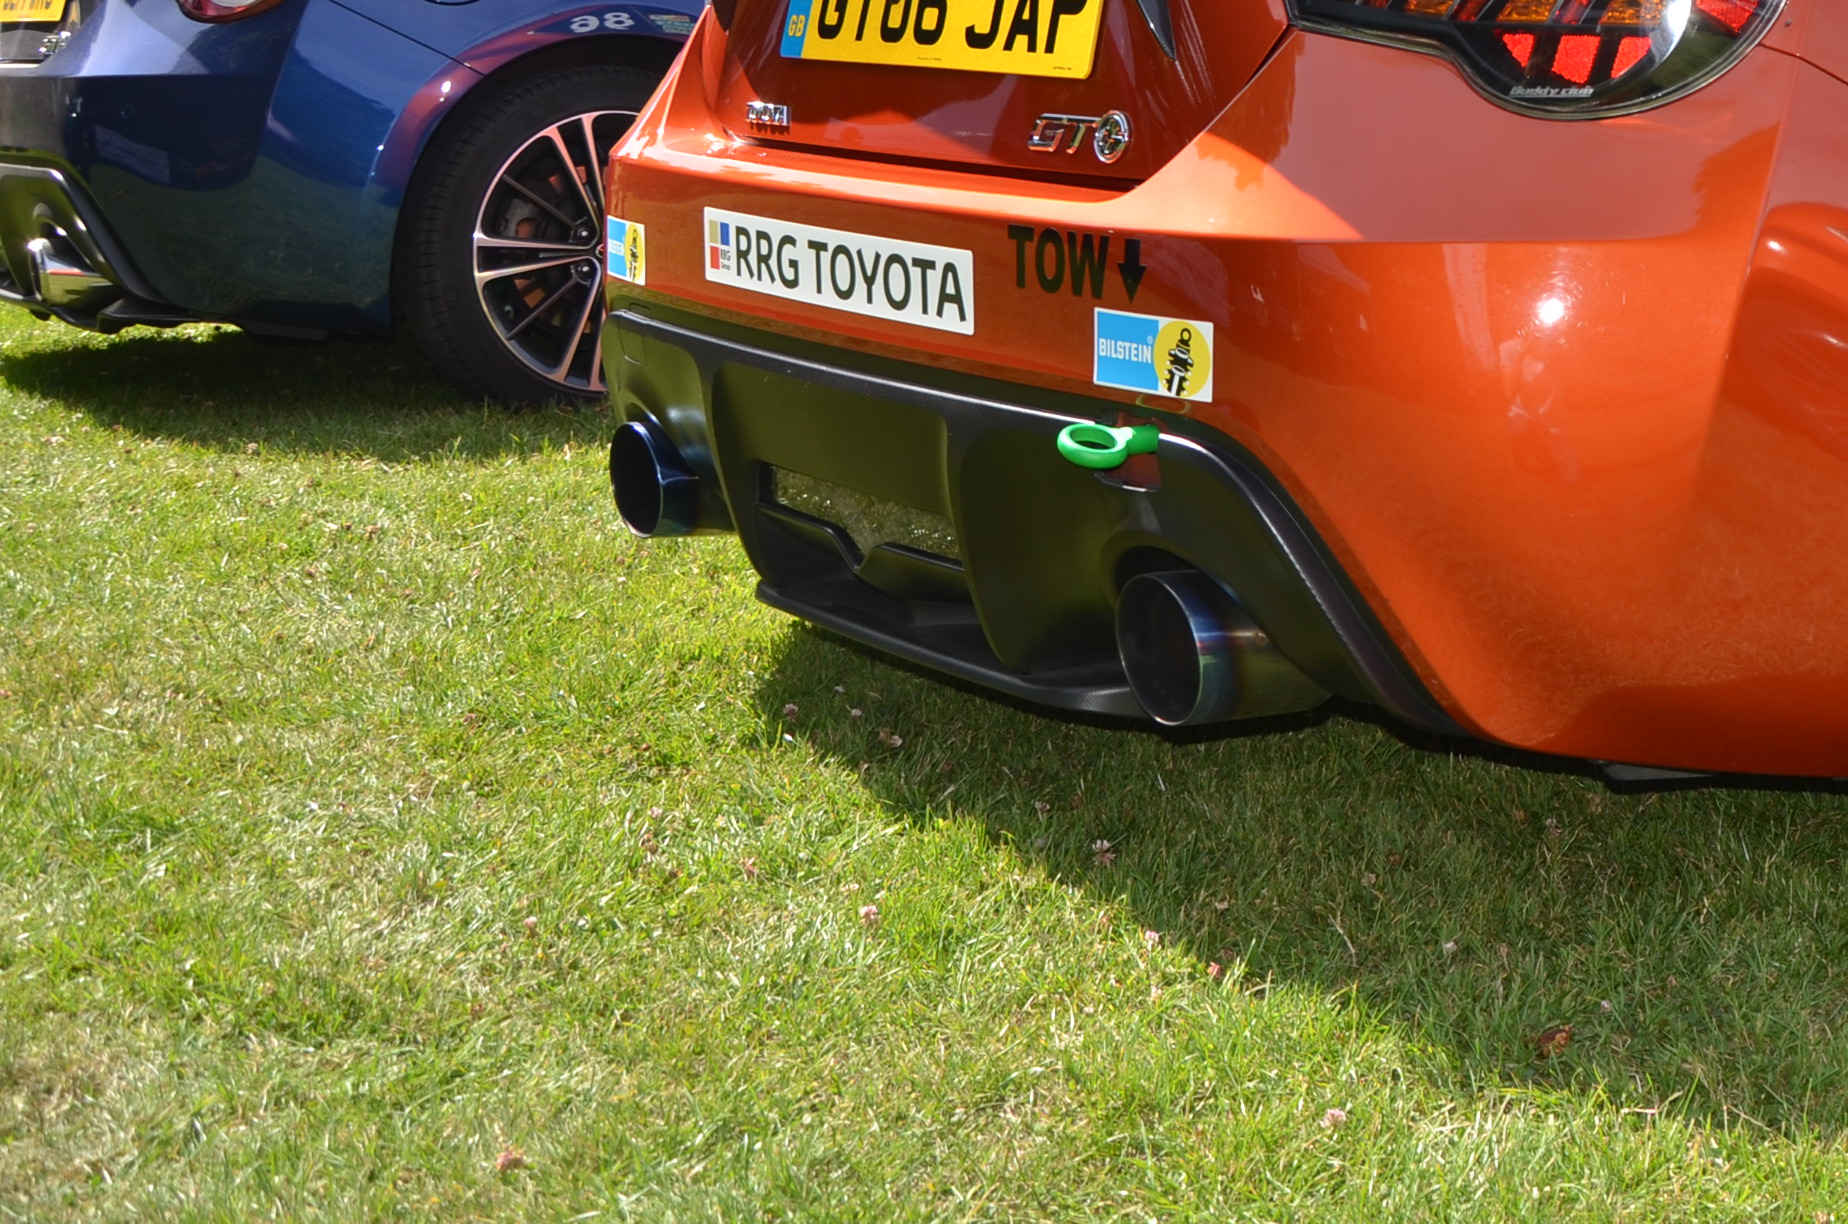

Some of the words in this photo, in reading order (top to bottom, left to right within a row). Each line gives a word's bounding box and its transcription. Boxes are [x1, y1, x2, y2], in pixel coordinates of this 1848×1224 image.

[788, 14, 807, 37] GB
[735, 224, 800, 290] RRG
[807, 238, 967, 323] TOYOTA
[1007, 222, 1110, 300] TOW
[1098, 337, 1152, 364] BILSTEIN
